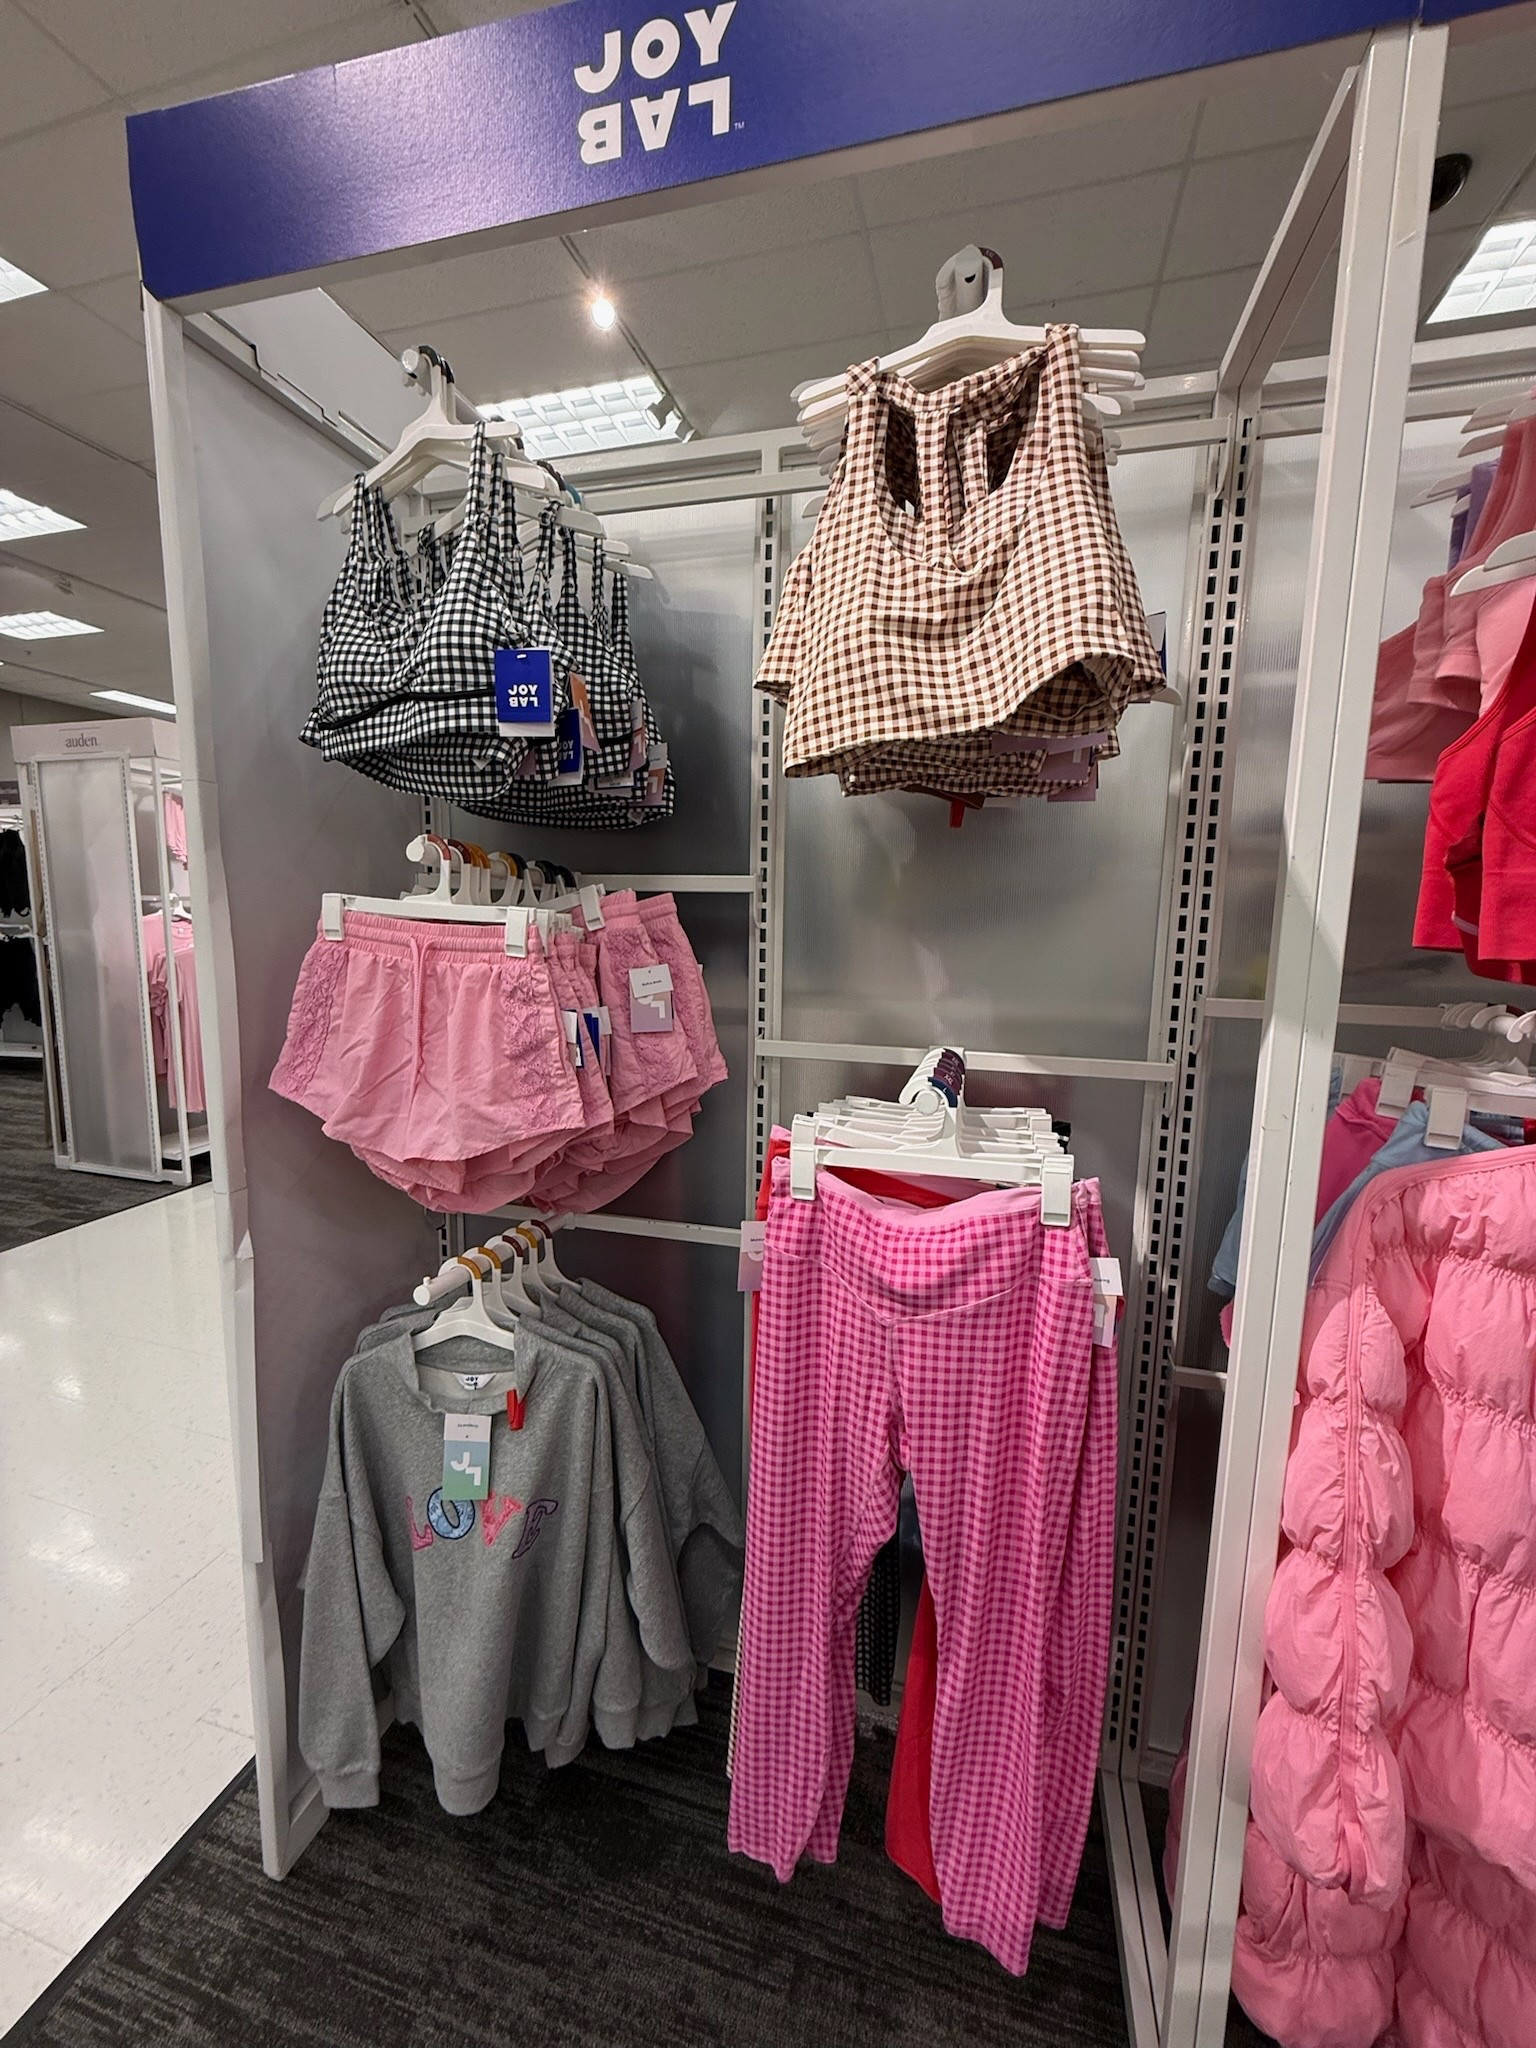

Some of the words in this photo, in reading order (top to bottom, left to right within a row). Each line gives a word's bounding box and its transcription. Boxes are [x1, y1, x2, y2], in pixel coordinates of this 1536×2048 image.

[574, 1, 737, 94] JOY
[578, 75, 731, 165] LAB
[507, 684, 538, 696] JOY
[509, 696, 539, 708] LAB
